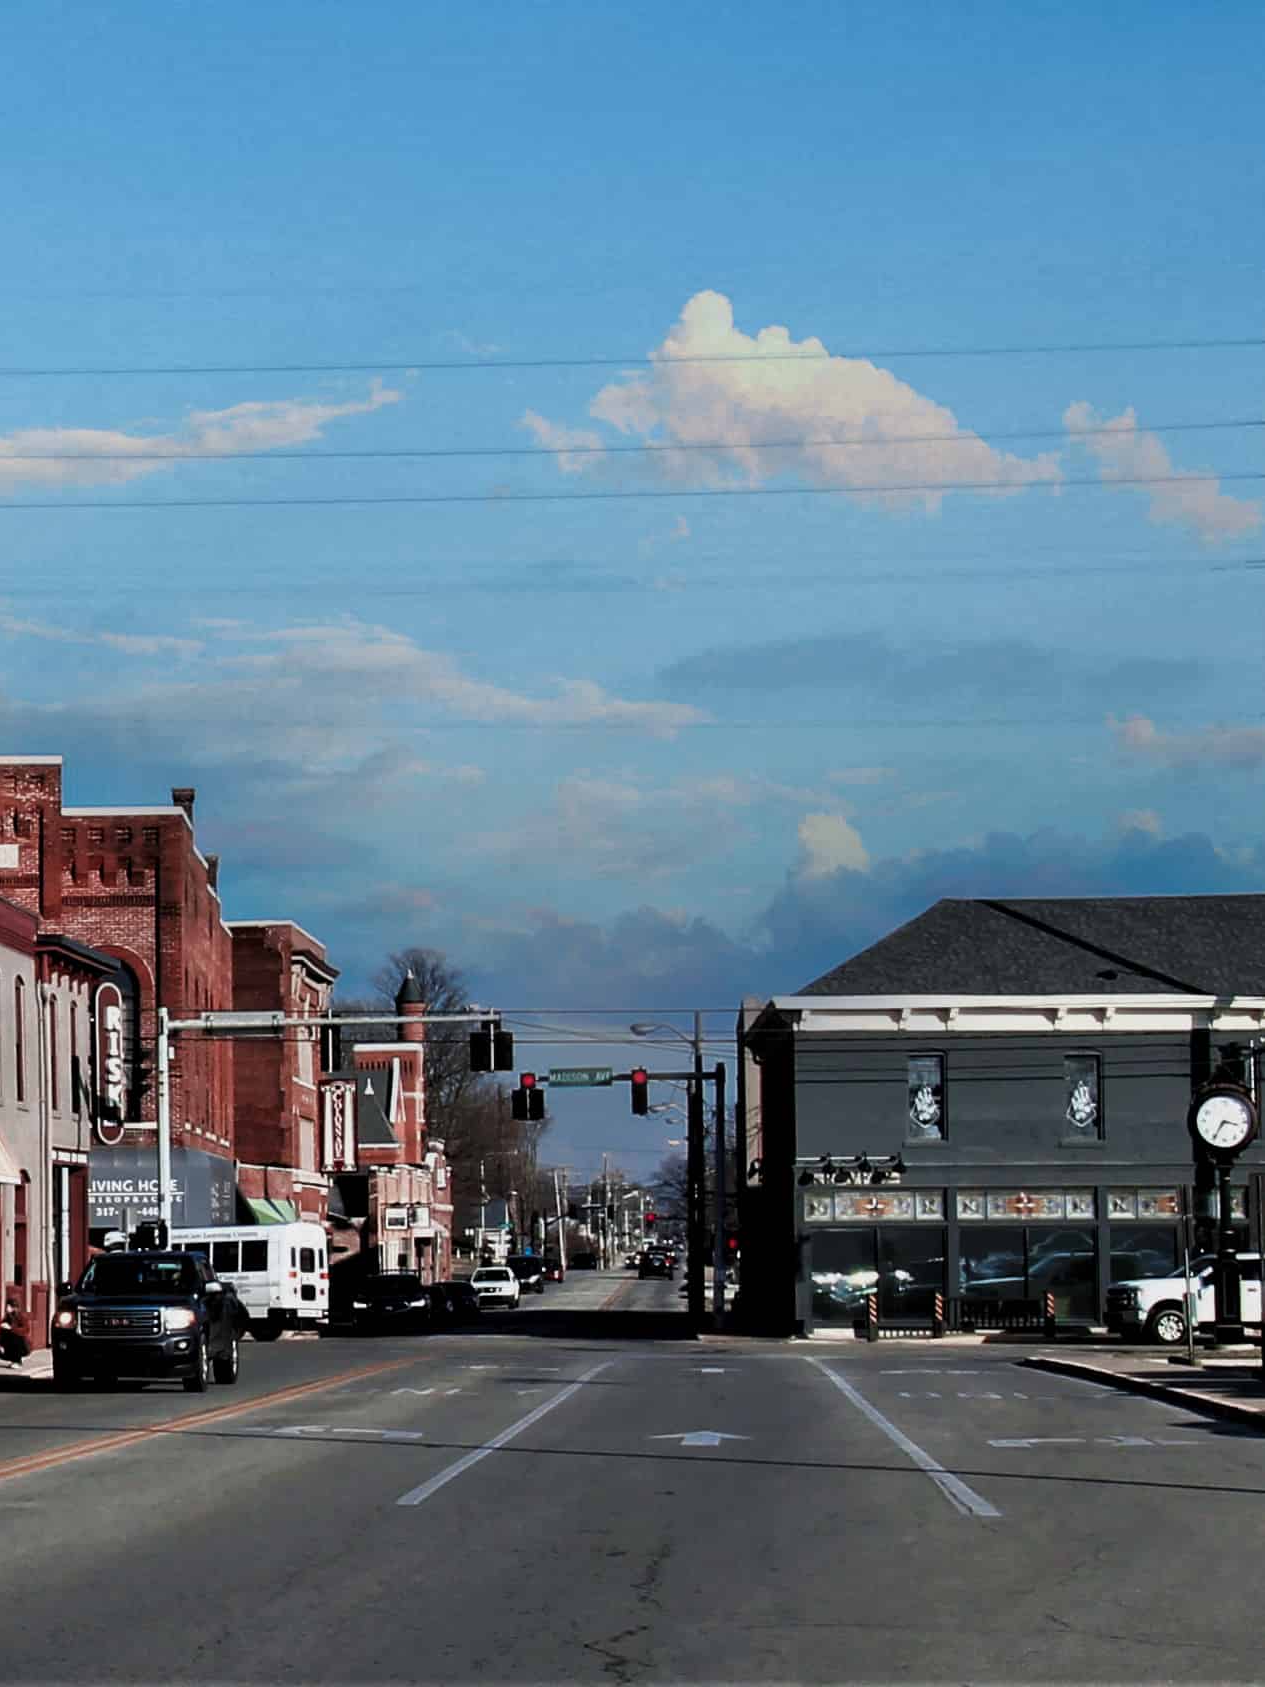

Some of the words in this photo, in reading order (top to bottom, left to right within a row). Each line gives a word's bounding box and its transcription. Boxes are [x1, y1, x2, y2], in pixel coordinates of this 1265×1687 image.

[549, 1072, 589, 1081] MADISON
[138, 1180, 179, 1192] HOE
[88, 1196, 183, 1204] HIROPRACIC
